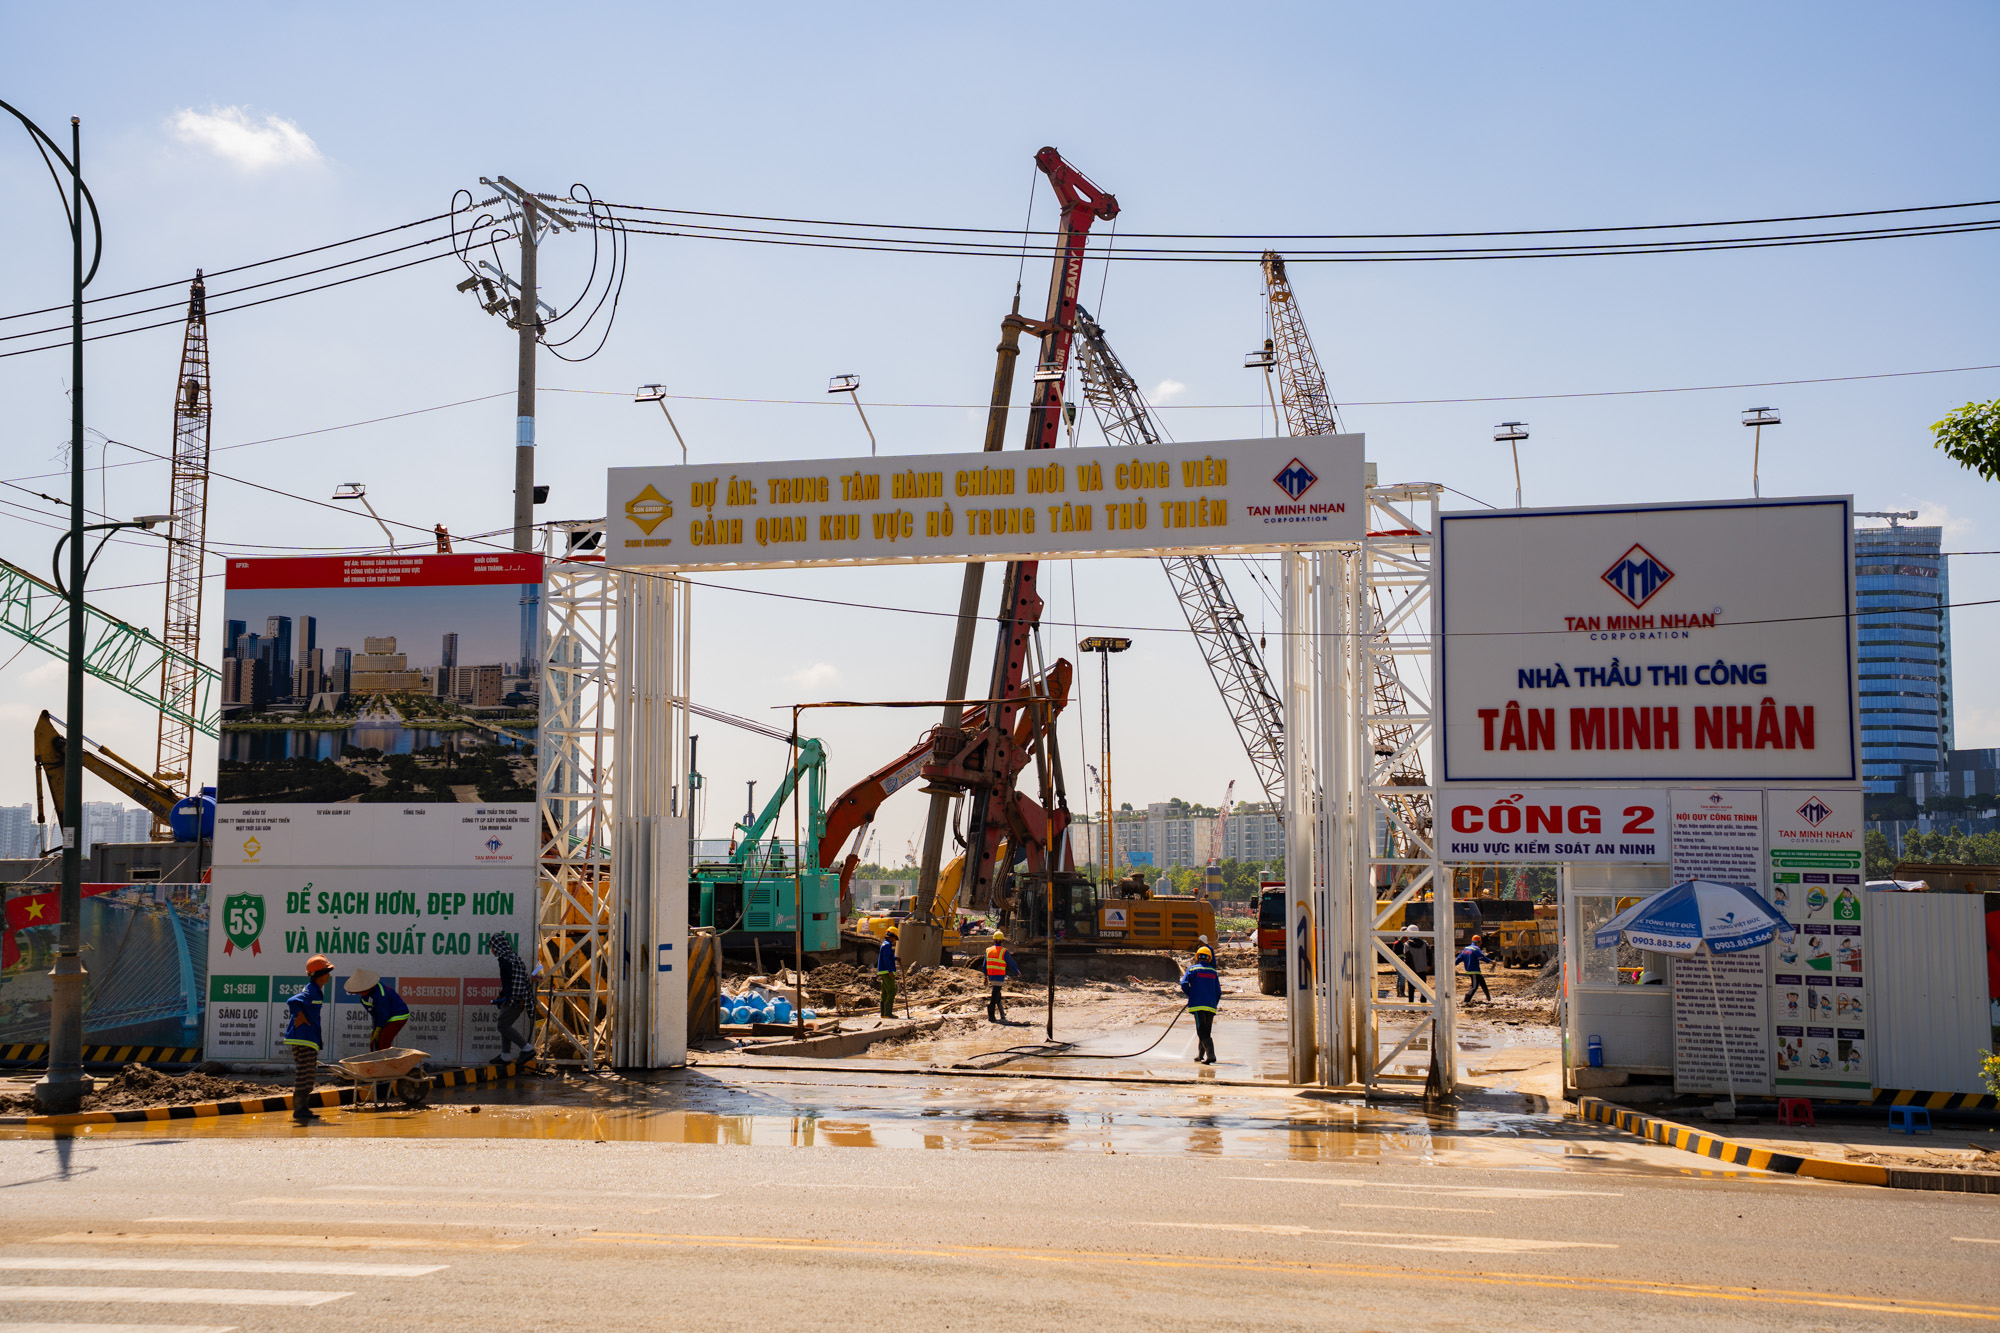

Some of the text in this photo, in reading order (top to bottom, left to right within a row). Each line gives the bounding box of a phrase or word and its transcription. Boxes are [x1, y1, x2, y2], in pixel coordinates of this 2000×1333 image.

[1066, 250, 1082, 298] SANY
[690, 456, 1226, 512] DỰ ÁN: TRUNG TÂM HÀNH CHÍNH MỚI VÀ CÔNG VIÊN
[1246, 503, 1344, 516] TAN MINH NHAN
[690, 496, 1226, 546] CẢNH QUAN KHU VỰC HỒ TRUNG TÂM THỦ THIÊM
[624, 538, 671, 548] SUN GROUP
[1564, 612, 1715, 632] TAN MINH NHAN
[1590, 631, 1689, 640] CORPORATION
[1518, 657, 1766, 688] NHÀ THẦU THI CÔNG
[1478, 696, 1814, 751] TÂN MINH NHÂN
[1451, 793, 1655, 834] CỔNG 2
[1676, 812, 1758, 822] NỘI QUY CÔNG TRÌNH
[1778, 830, 1852, 839] TAN MINH NHAN
[1452, 839, 1655, 856] KHU VỰC KIỂM SOÁT AN NINH
[286, 882, 514, 920] ĐỂ SẠCH HƠN, ĐẸP HƠN
[228, 907, 258, 936] 5S
[285, 930, 309, 954] VÀ
[316, 926, 370, 954] NĂNG
[376, 924, 426, 955] SUẤT
[432, 932, 471, 955] CAO
[1632, 936, 1692, 949] 0903.883.566
[224, 984, 256, 995] S1-SERI
[402, 986, 456, 998] S4-SEIKETSU
[218, 1006, 258, 1022] SÀNG LỌC
[346, 1010, 368, 1023] SẠCH
[430, 1010, 446, 1022] SÓC
